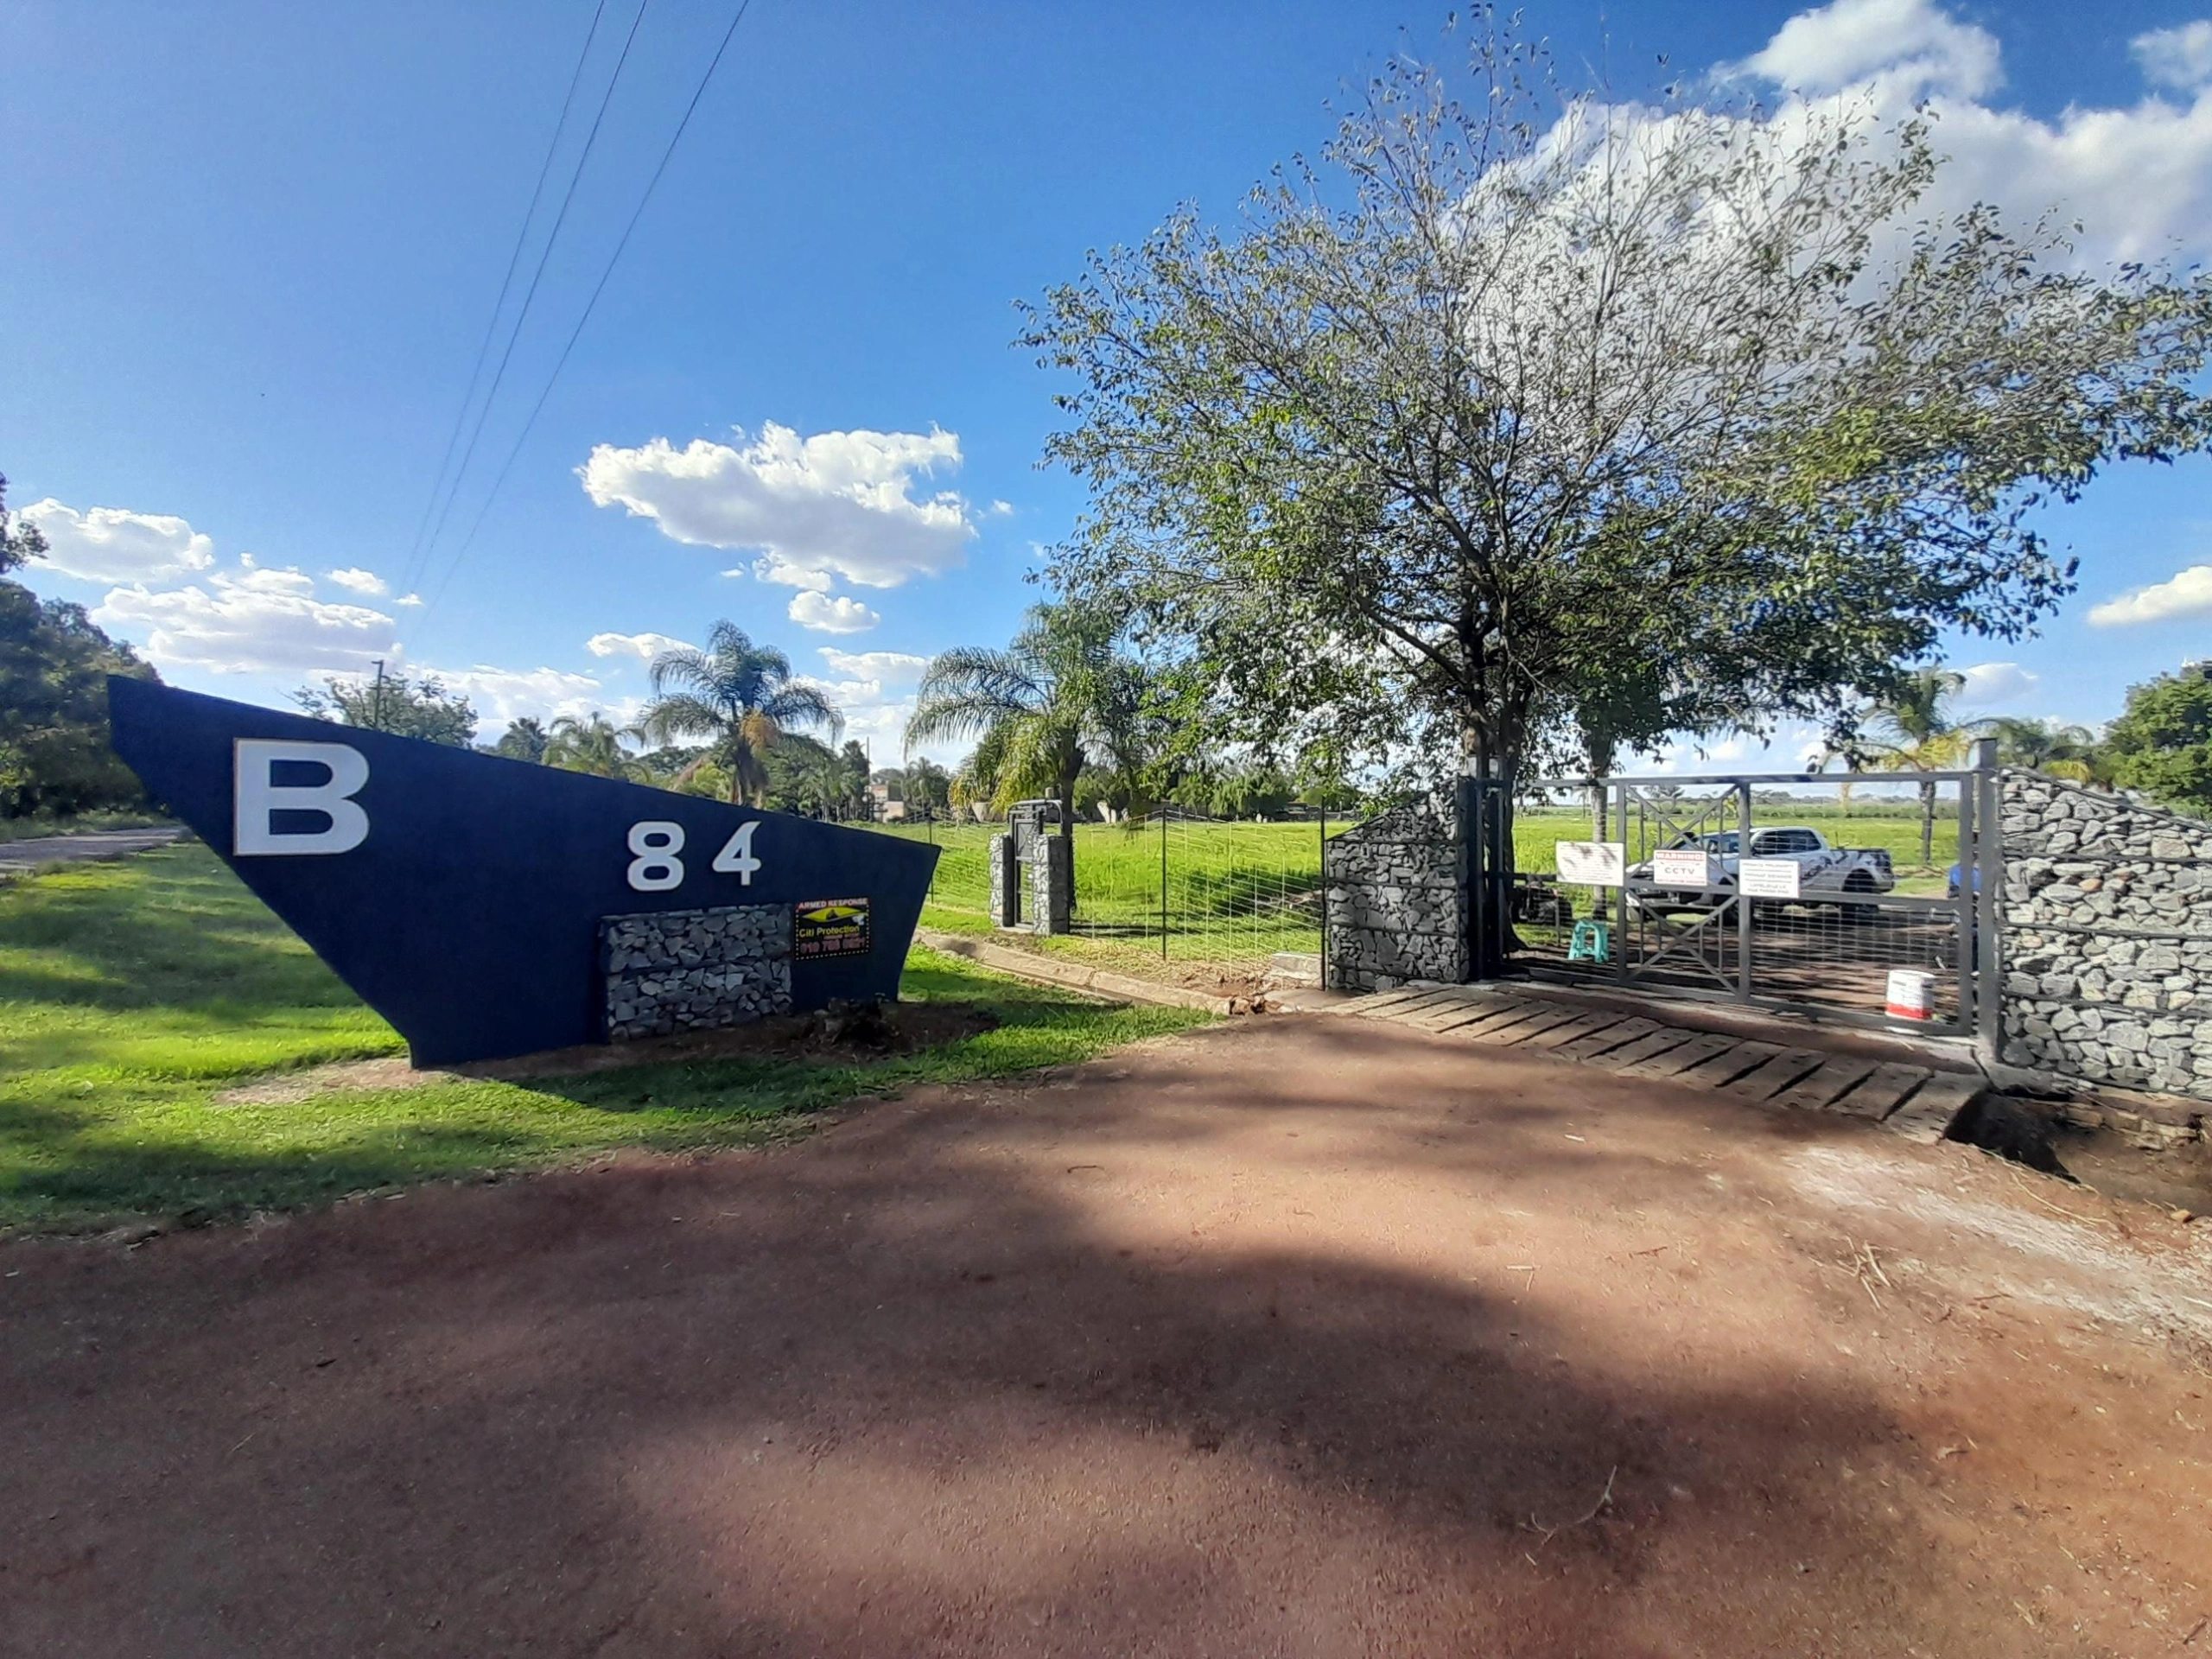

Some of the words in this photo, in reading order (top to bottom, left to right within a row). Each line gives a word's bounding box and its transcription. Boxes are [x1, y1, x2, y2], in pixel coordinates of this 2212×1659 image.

[233, 738, 370, 856] B
[798, 900, 827, 910] ARMED
[828, 898, 868, 907] RESPONSE
[817, 925, 860, 936] Protection
